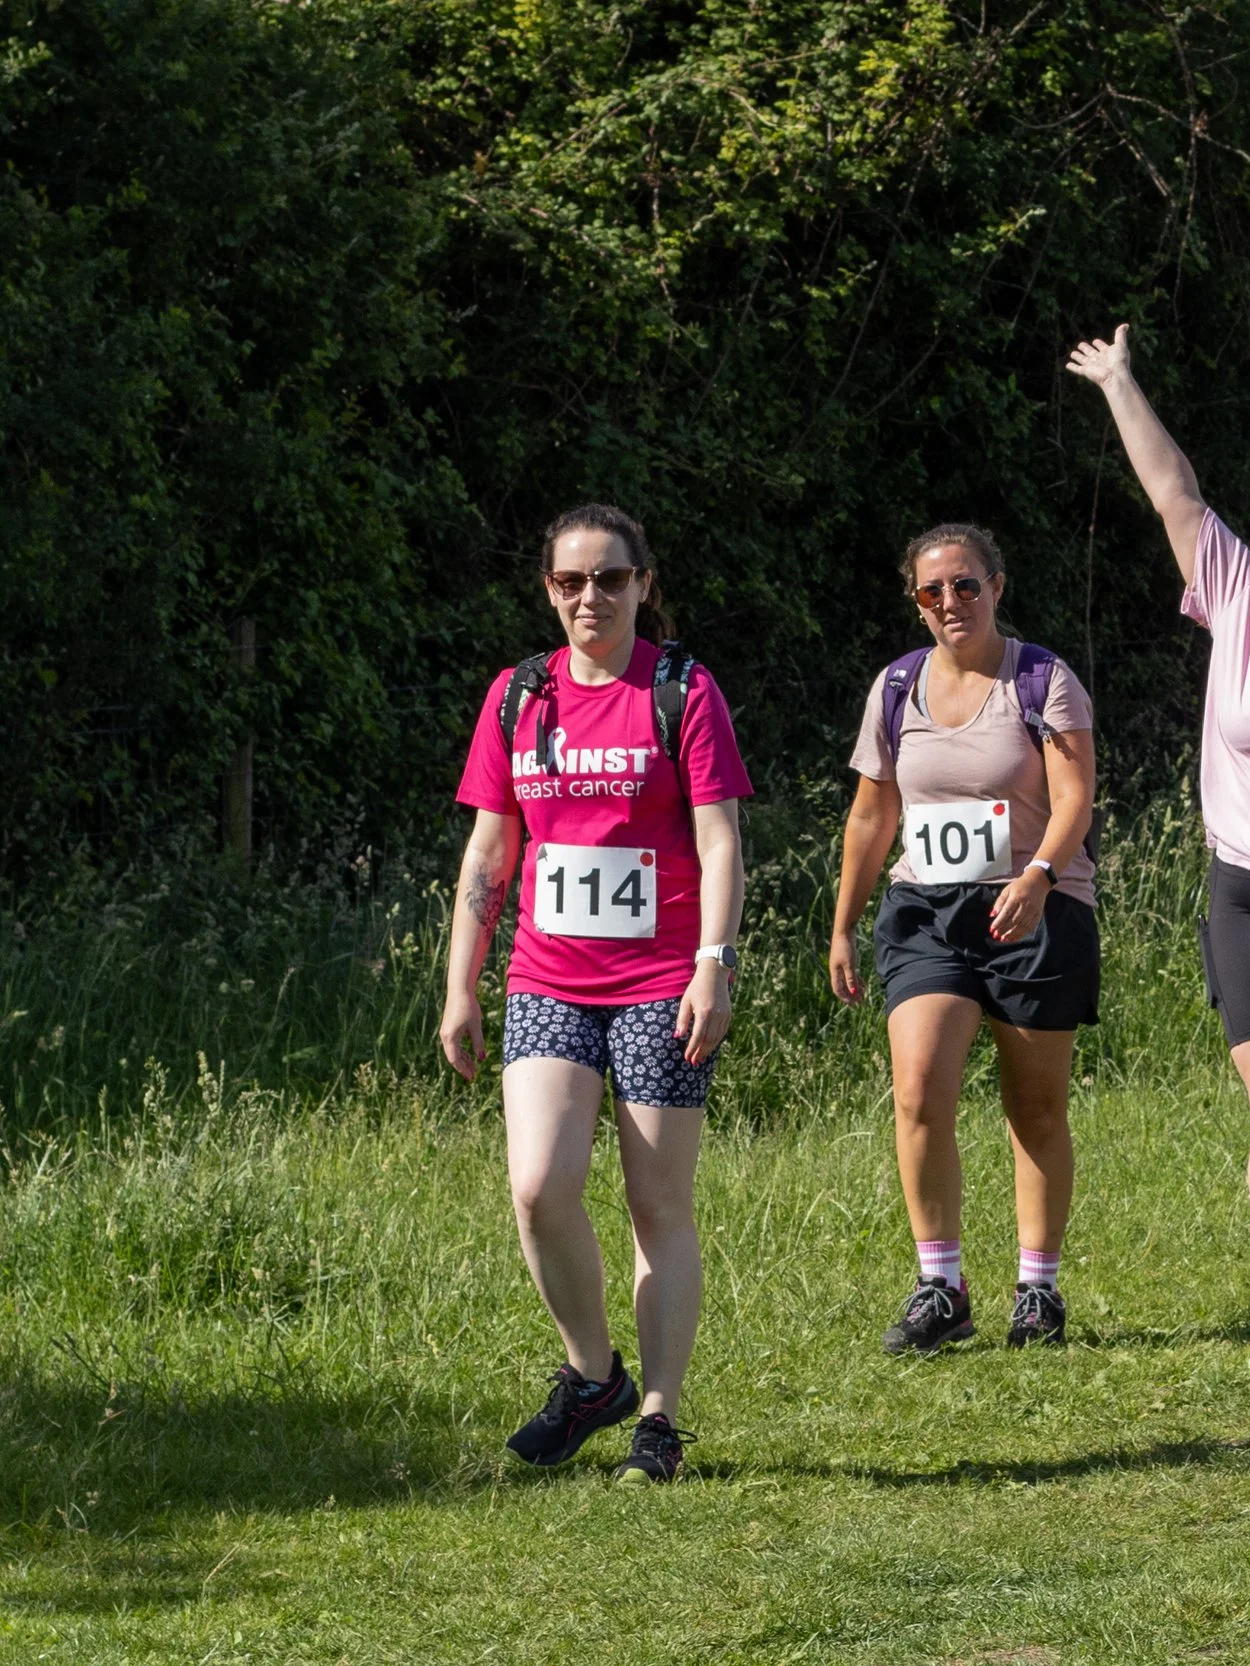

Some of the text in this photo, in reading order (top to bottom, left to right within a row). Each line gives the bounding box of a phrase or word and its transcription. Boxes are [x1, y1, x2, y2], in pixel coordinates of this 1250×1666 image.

[568, 779, 645, 797] cancer
[915, 819, 996, 866] 101
[547, 866, 647, 918] 114
